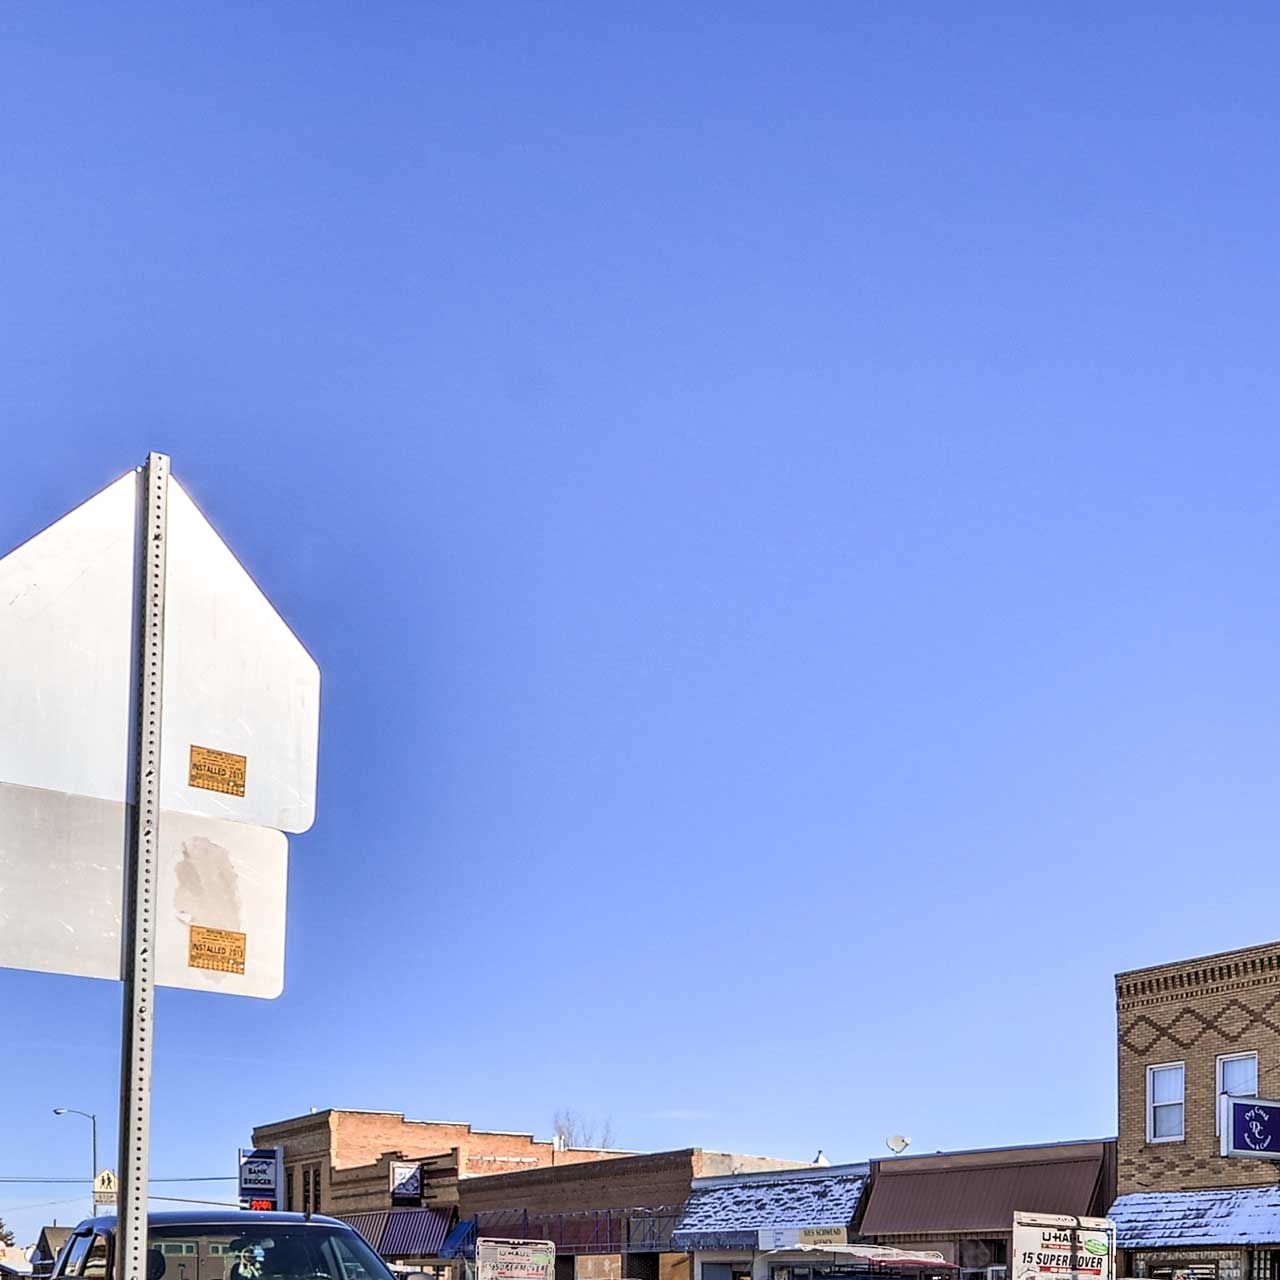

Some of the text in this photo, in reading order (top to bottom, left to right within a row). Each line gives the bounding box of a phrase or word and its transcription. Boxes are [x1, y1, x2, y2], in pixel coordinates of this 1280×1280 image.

[191, 763, 227, 776] INSTALLED
[191, 943, 227, 955] INSTALLED
[248, 1167, 268, 1175] BANK
